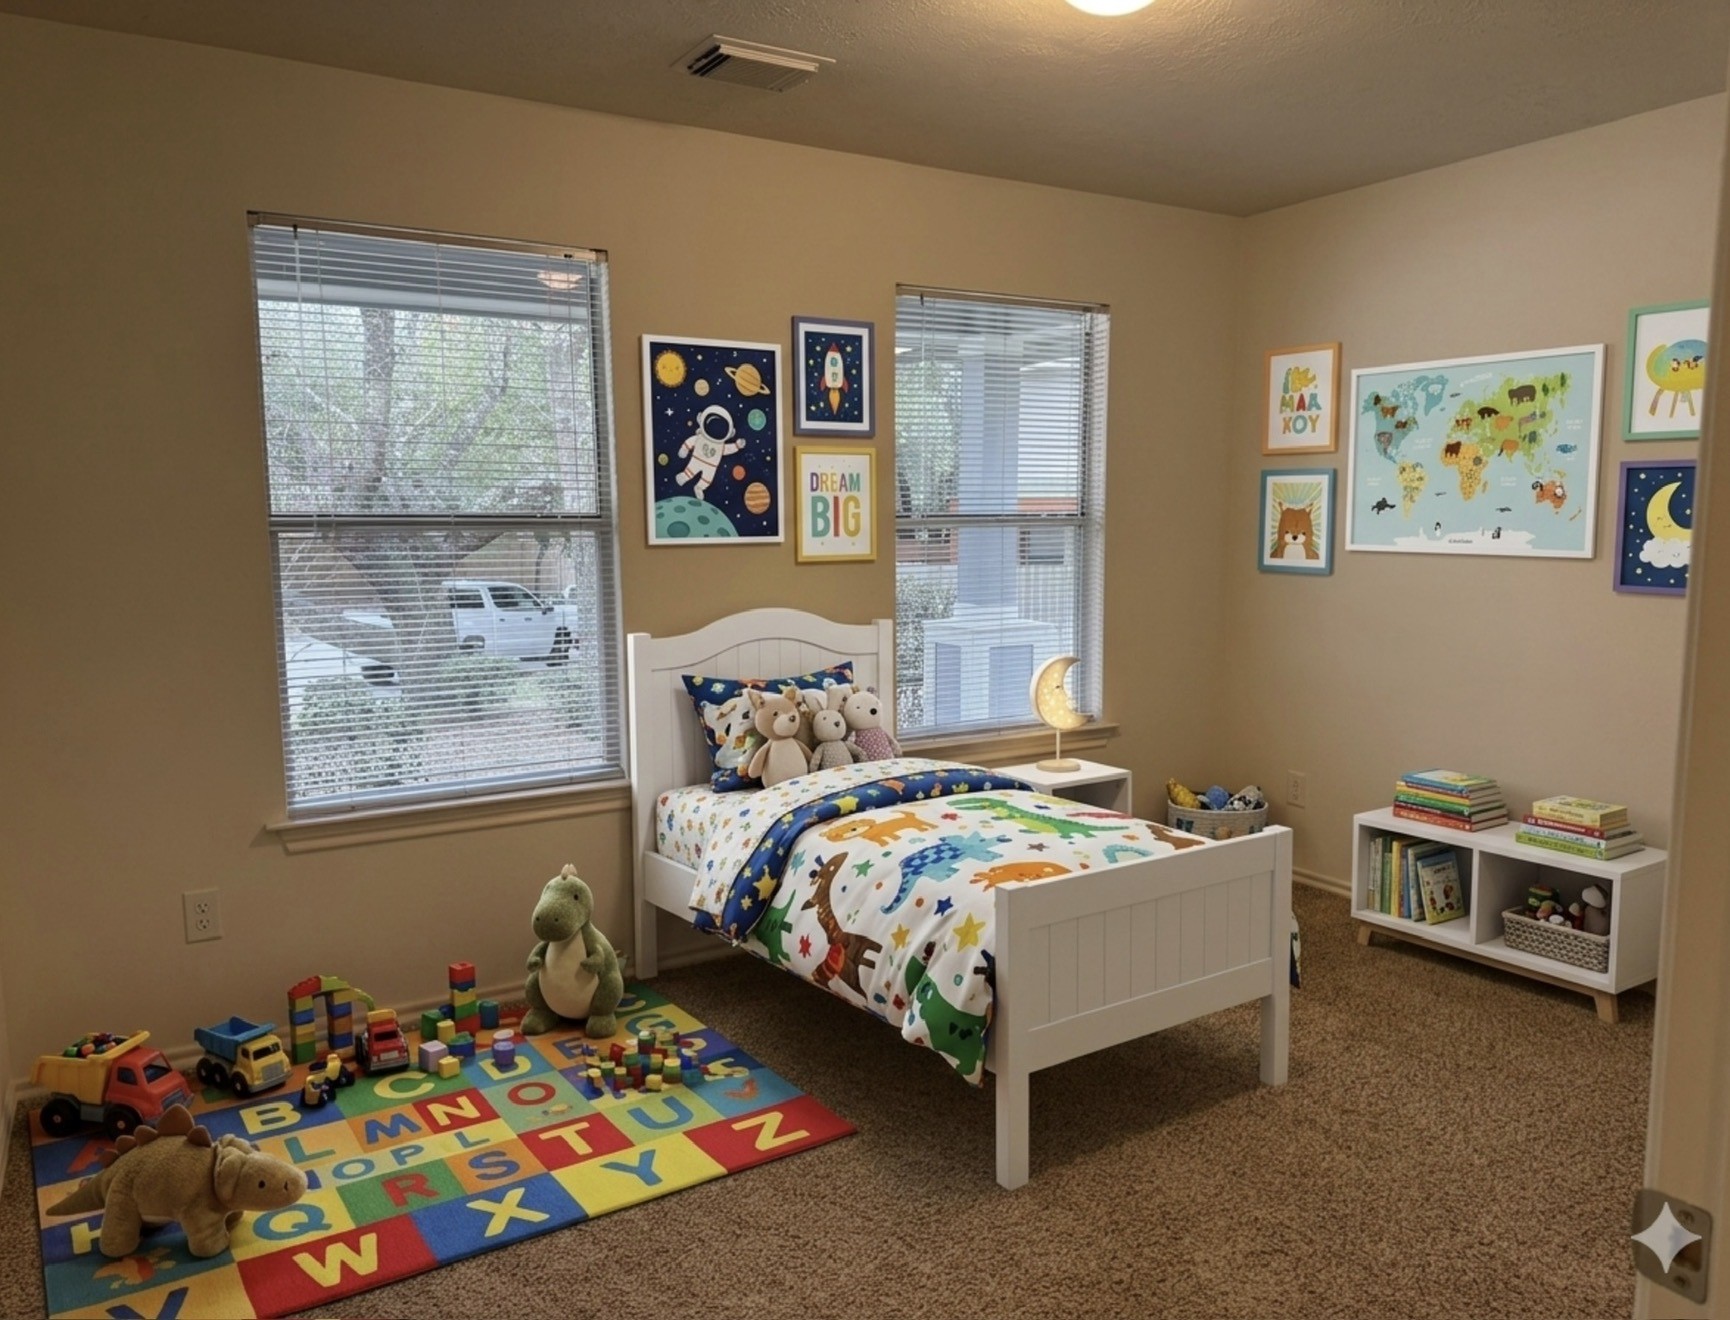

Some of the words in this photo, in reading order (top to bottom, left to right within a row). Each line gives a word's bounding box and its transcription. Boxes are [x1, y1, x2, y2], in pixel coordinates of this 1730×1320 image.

[809, 471, 861, 493] DREAM
[811, 495, 861, 538] BIG
[373, 1071, 436, 1099] C
[478, 1056, 532, 1081] D
[507, 1081, 556, 1107] O
[239, 1101, 302, 1135] B
[426, 1095, 481, 1127] N
[627, 1095, 694, 1131] U
[364, 1112, 422, 1145] M
[454, 1131, 491, 1149] L
[538, 1121, 593, 1157] T
[731, 1111, 811, 1152] Z
[284, 1136, 336, 1165] L
[390, 1144, 424, 1167] P
[468, 1150, 521, 1181] S
[331, 1158, 375, 1180] O
[601, 1148, 664, 1187] Y
[381, 1172, 440, 1209] R
[253, 1203, 333, 1241] Q
[466, 1187, 550, 1238] X
[292, 1232, 378, 1288] W
